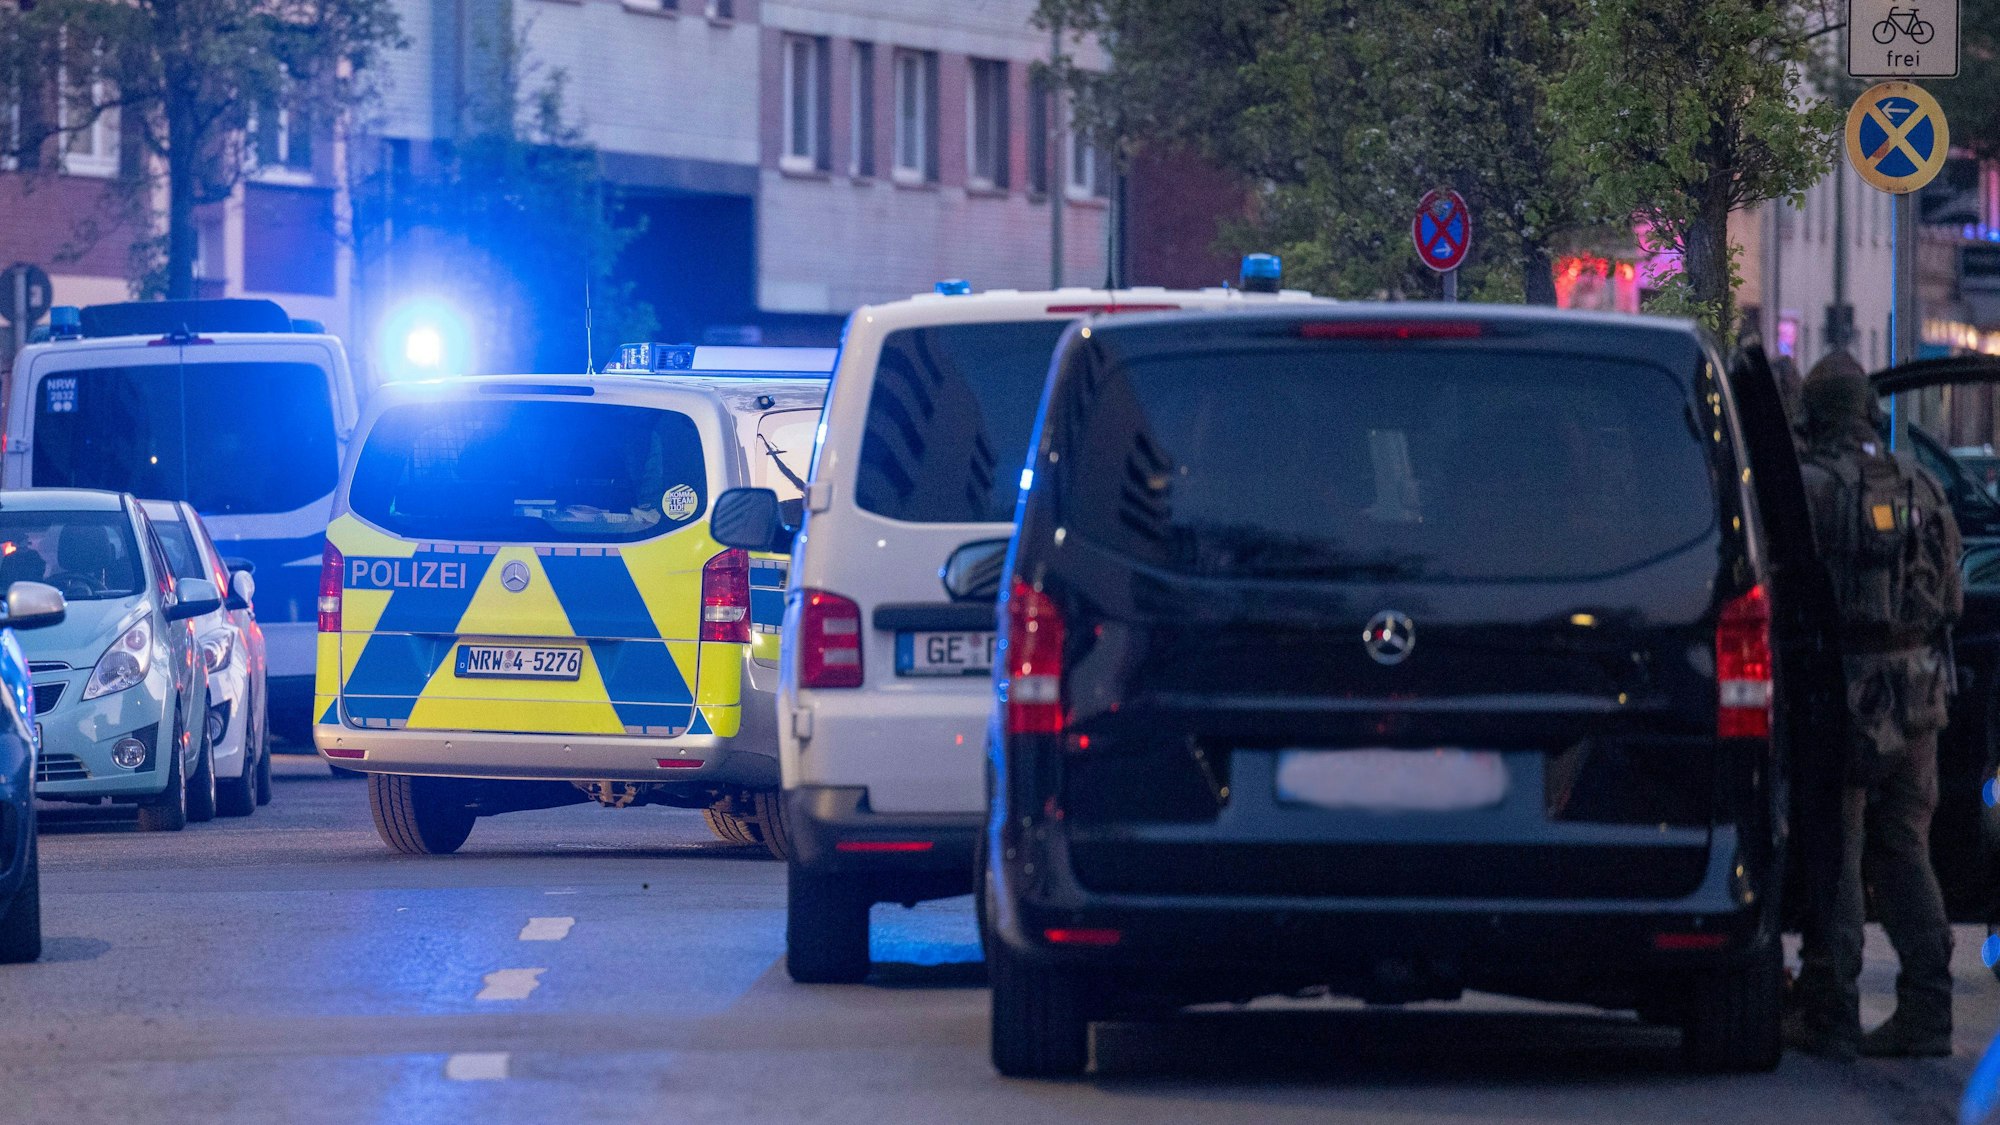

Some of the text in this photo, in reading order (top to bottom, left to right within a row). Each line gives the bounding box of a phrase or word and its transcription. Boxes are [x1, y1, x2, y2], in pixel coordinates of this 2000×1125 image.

[1887, 50, 1920, 67] frei
[47, 379, 76, 390] NRW
[671, 496, 694, 505] TEAM
[351, 560, 466, 589] POLIZEI
[927, 636, 964, 664] GE
[468, 650, 578, 673] NRW 4-5276
